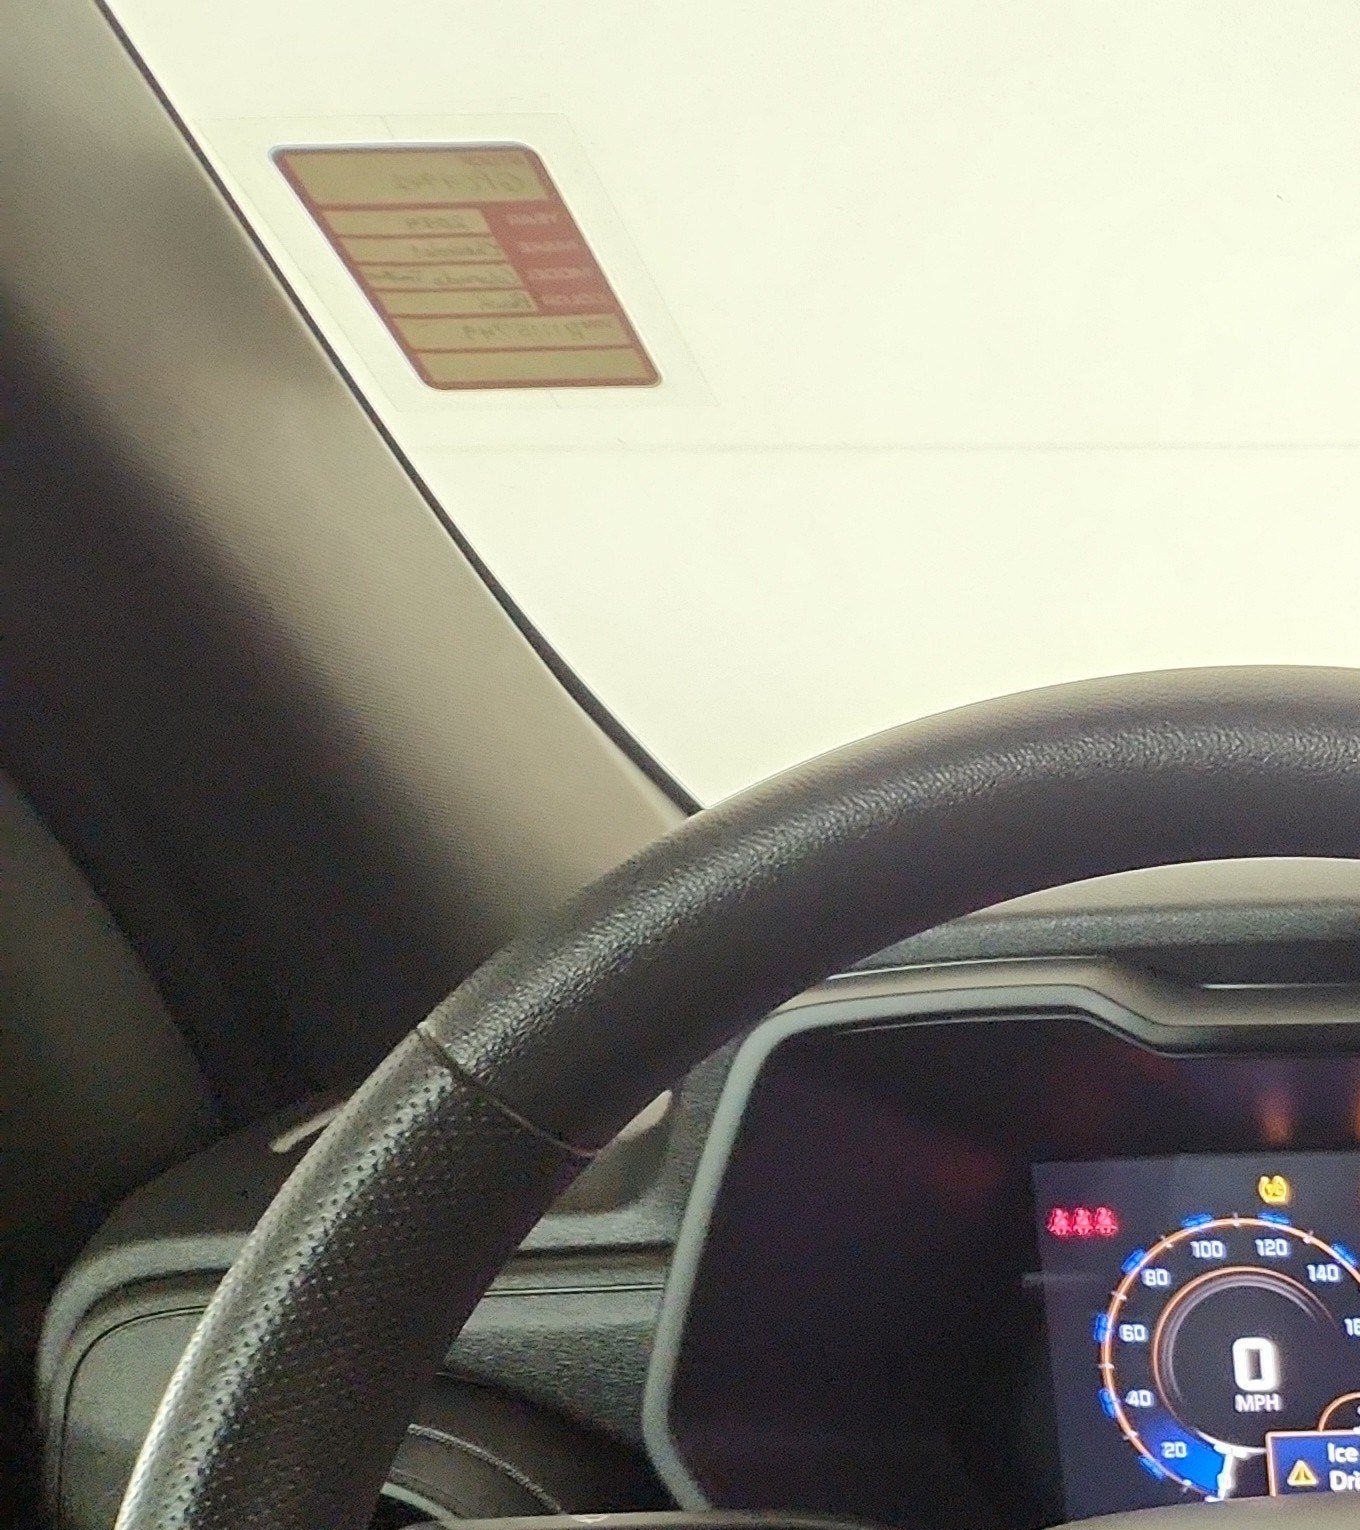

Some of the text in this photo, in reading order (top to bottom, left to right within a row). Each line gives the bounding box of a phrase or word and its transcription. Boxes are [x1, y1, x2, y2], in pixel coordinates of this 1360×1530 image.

[1191, 1240, 1226, 1259] 100
[1256, 1239, 1288, 1257] 120
[1142, 1268, 1170, 1287] 80
[1307, 1264, 1340, 1282] 140
[1120, 1323, 1148, 1343] 60
[1232, 1336, 1279, 1392] 0
[1125, 1389, 1153, 1408] 40
[1234, 1394, 1282, 1412] MPH
[1161, 1441, 1187, 1459] 20
[1327, 1443, 1360, 1464] Ice
